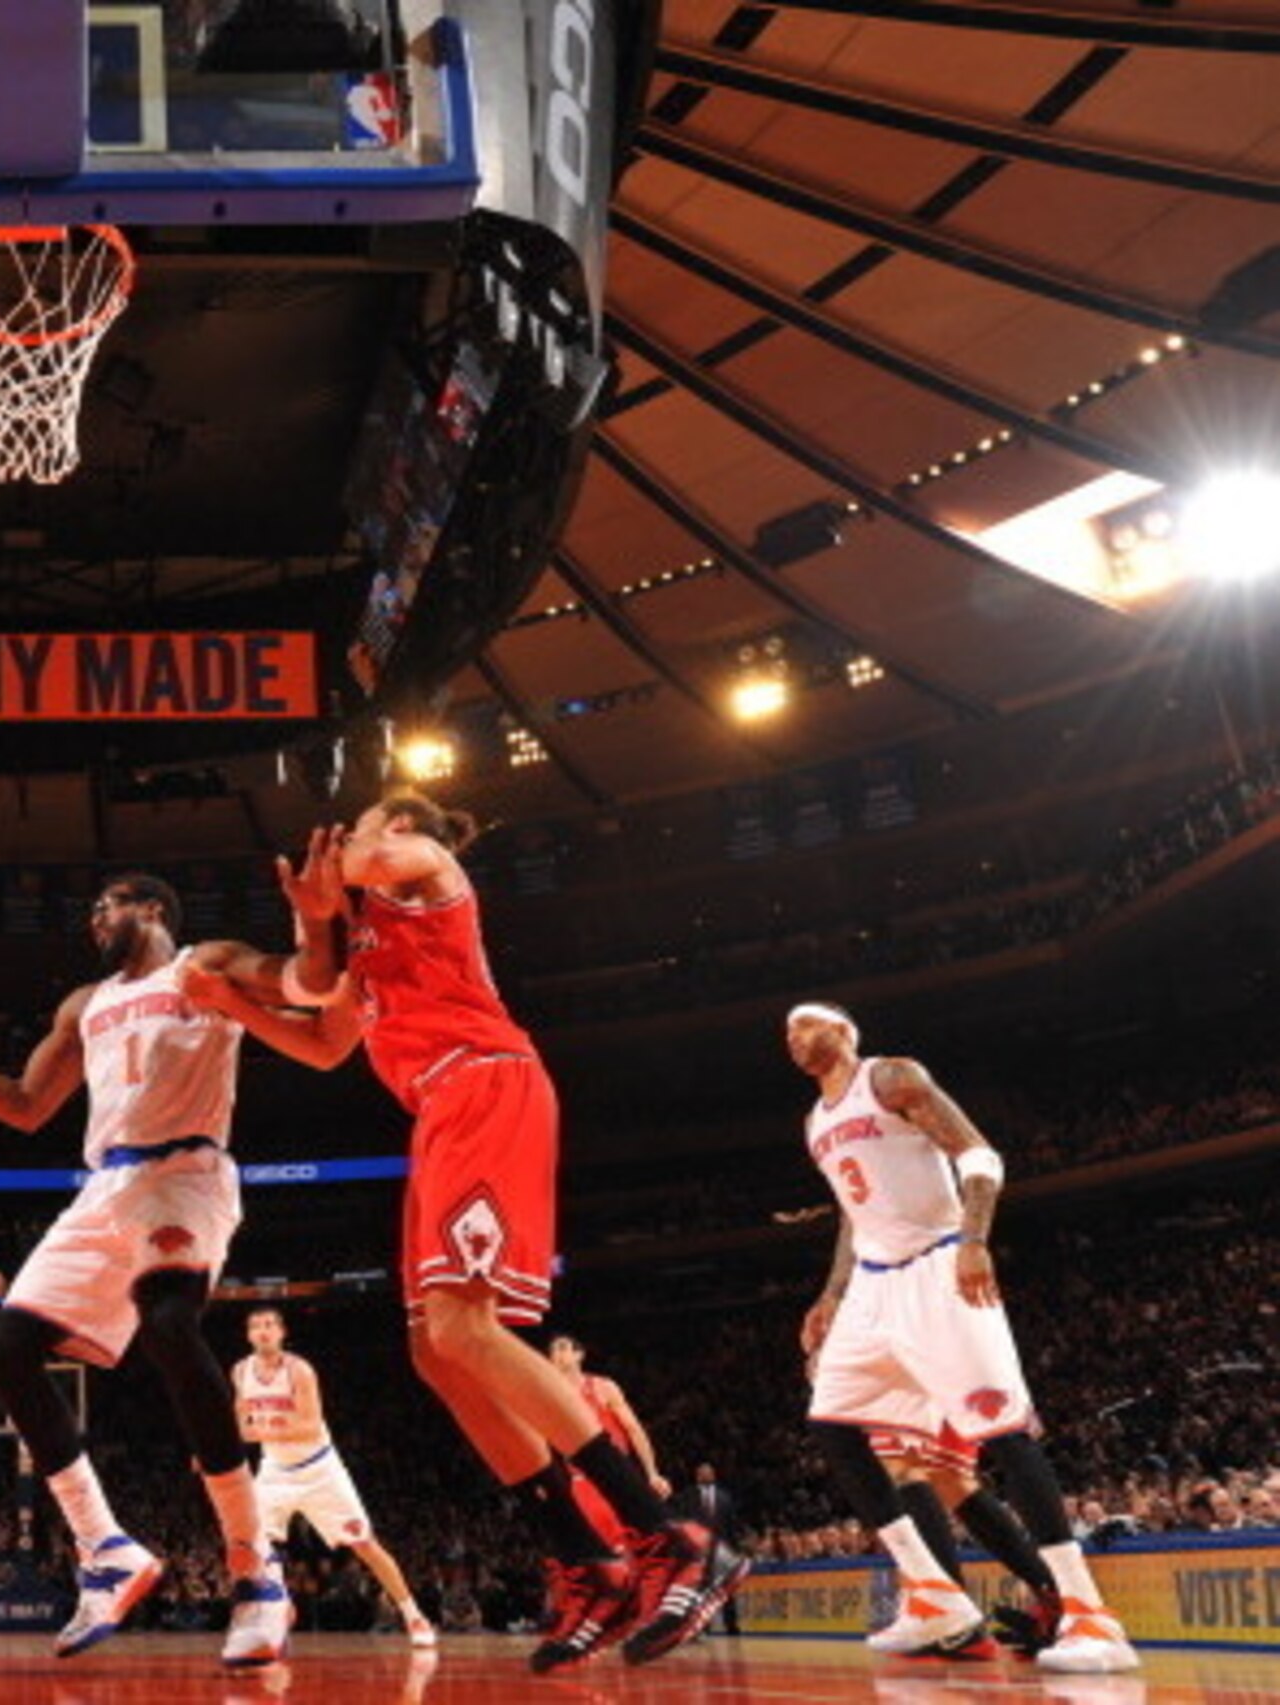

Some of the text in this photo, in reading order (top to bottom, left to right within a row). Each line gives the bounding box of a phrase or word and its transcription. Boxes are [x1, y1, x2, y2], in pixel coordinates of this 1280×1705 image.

[75, 636, 288, 713] MADE
[125, 1031, 142, 1085] 1
[839, 1158, 870, 1204] 3
[1172, 1567, 1260, 1627] VOTE
